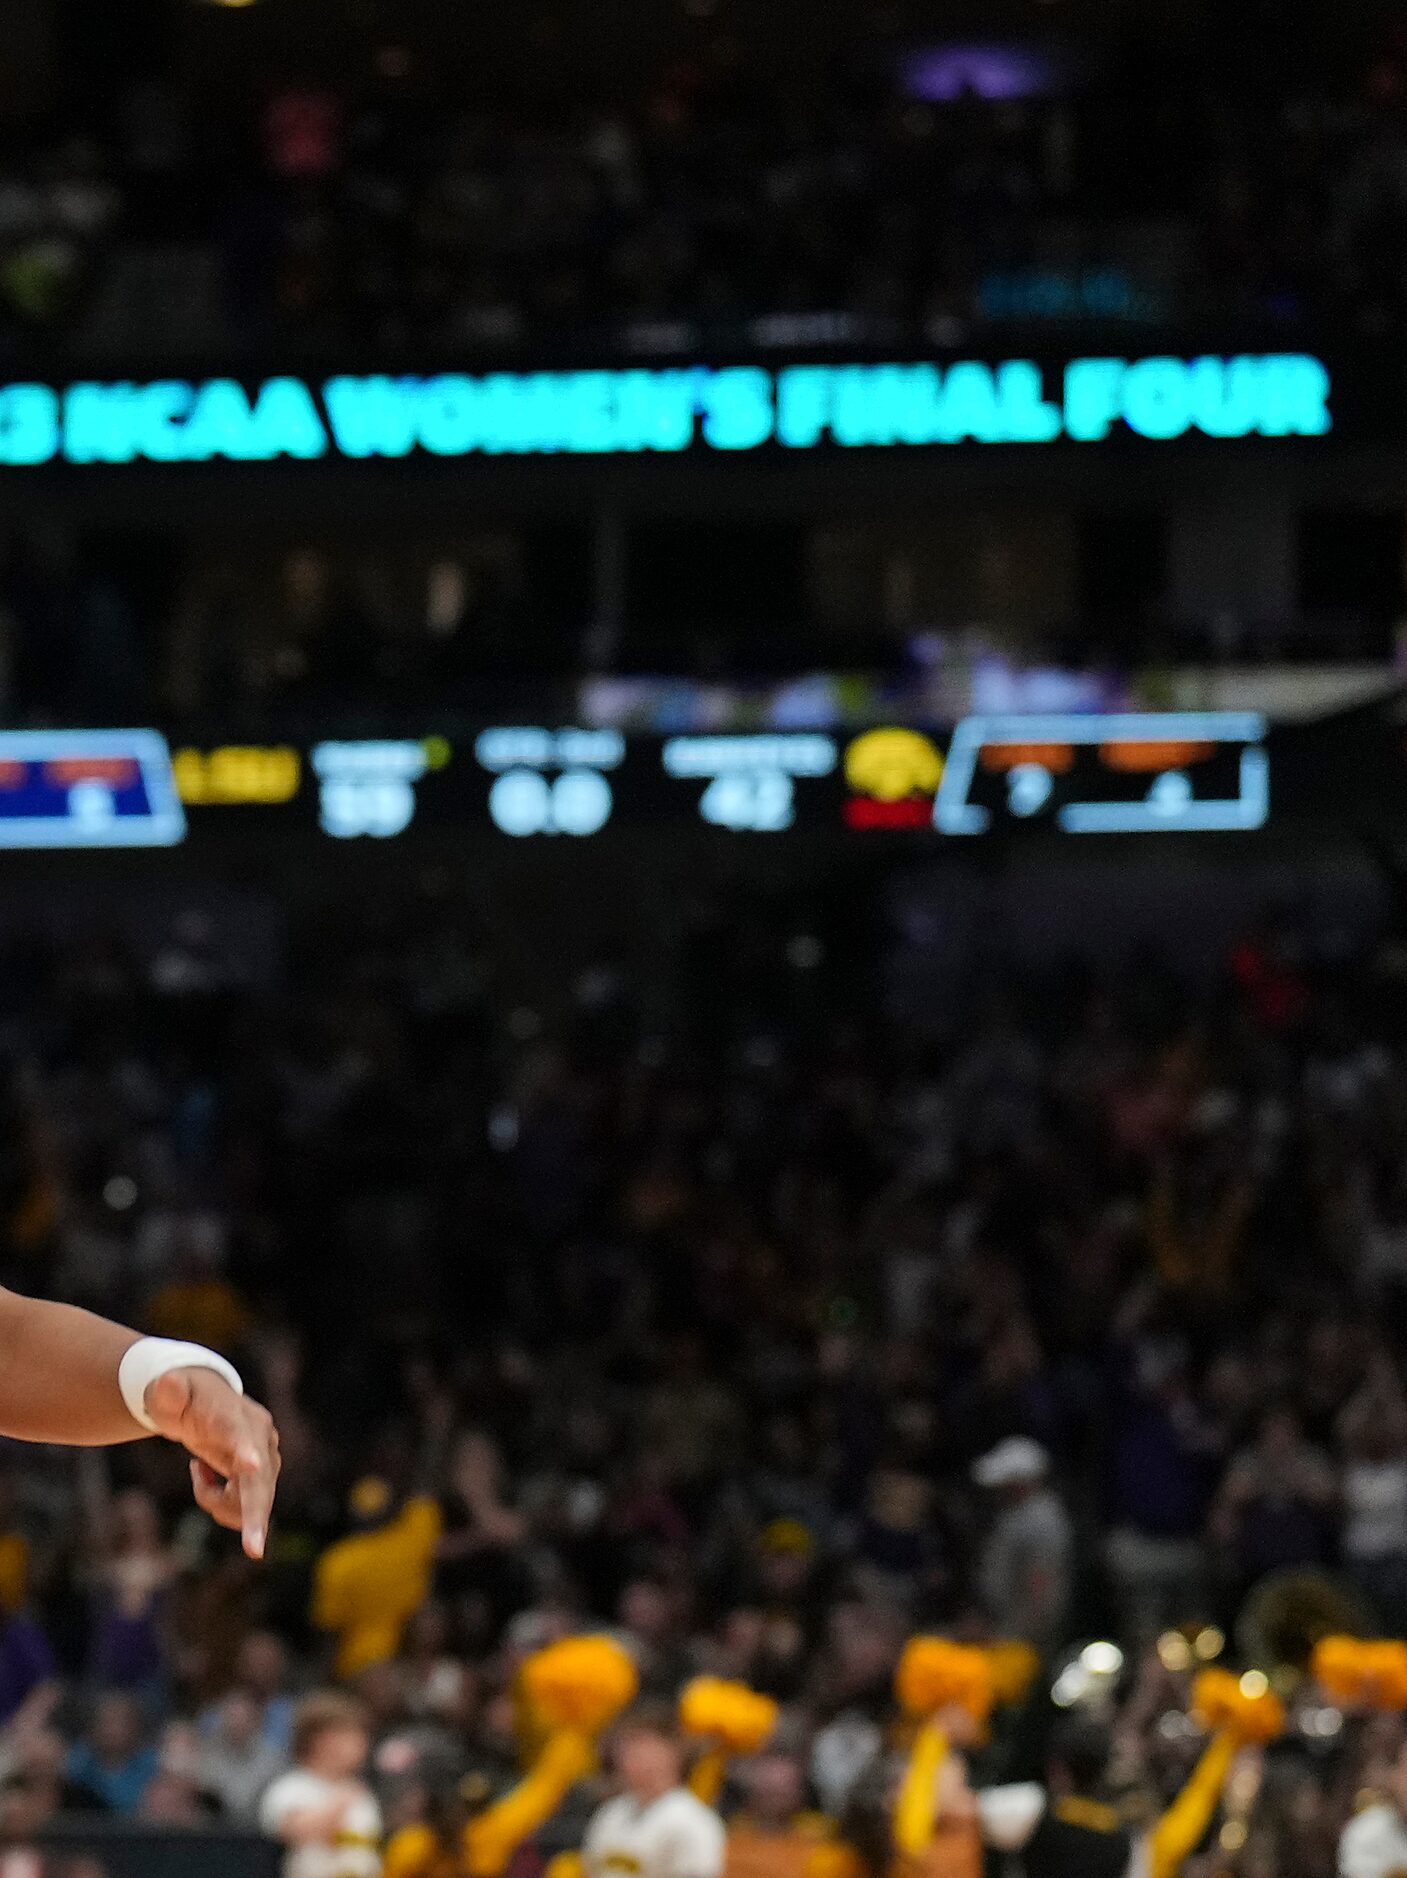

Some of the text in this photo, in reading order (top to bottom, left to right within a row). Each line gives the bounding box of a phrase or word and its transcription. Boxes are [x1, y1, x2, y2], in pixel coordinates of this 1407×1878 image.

[62, 378, 325, 463] NCAA
[323, 368, 774, 458] WOMEN'S
[776, 361, 1062, 447] FINAL
[1064, 355, 1328, 441] FOUR
